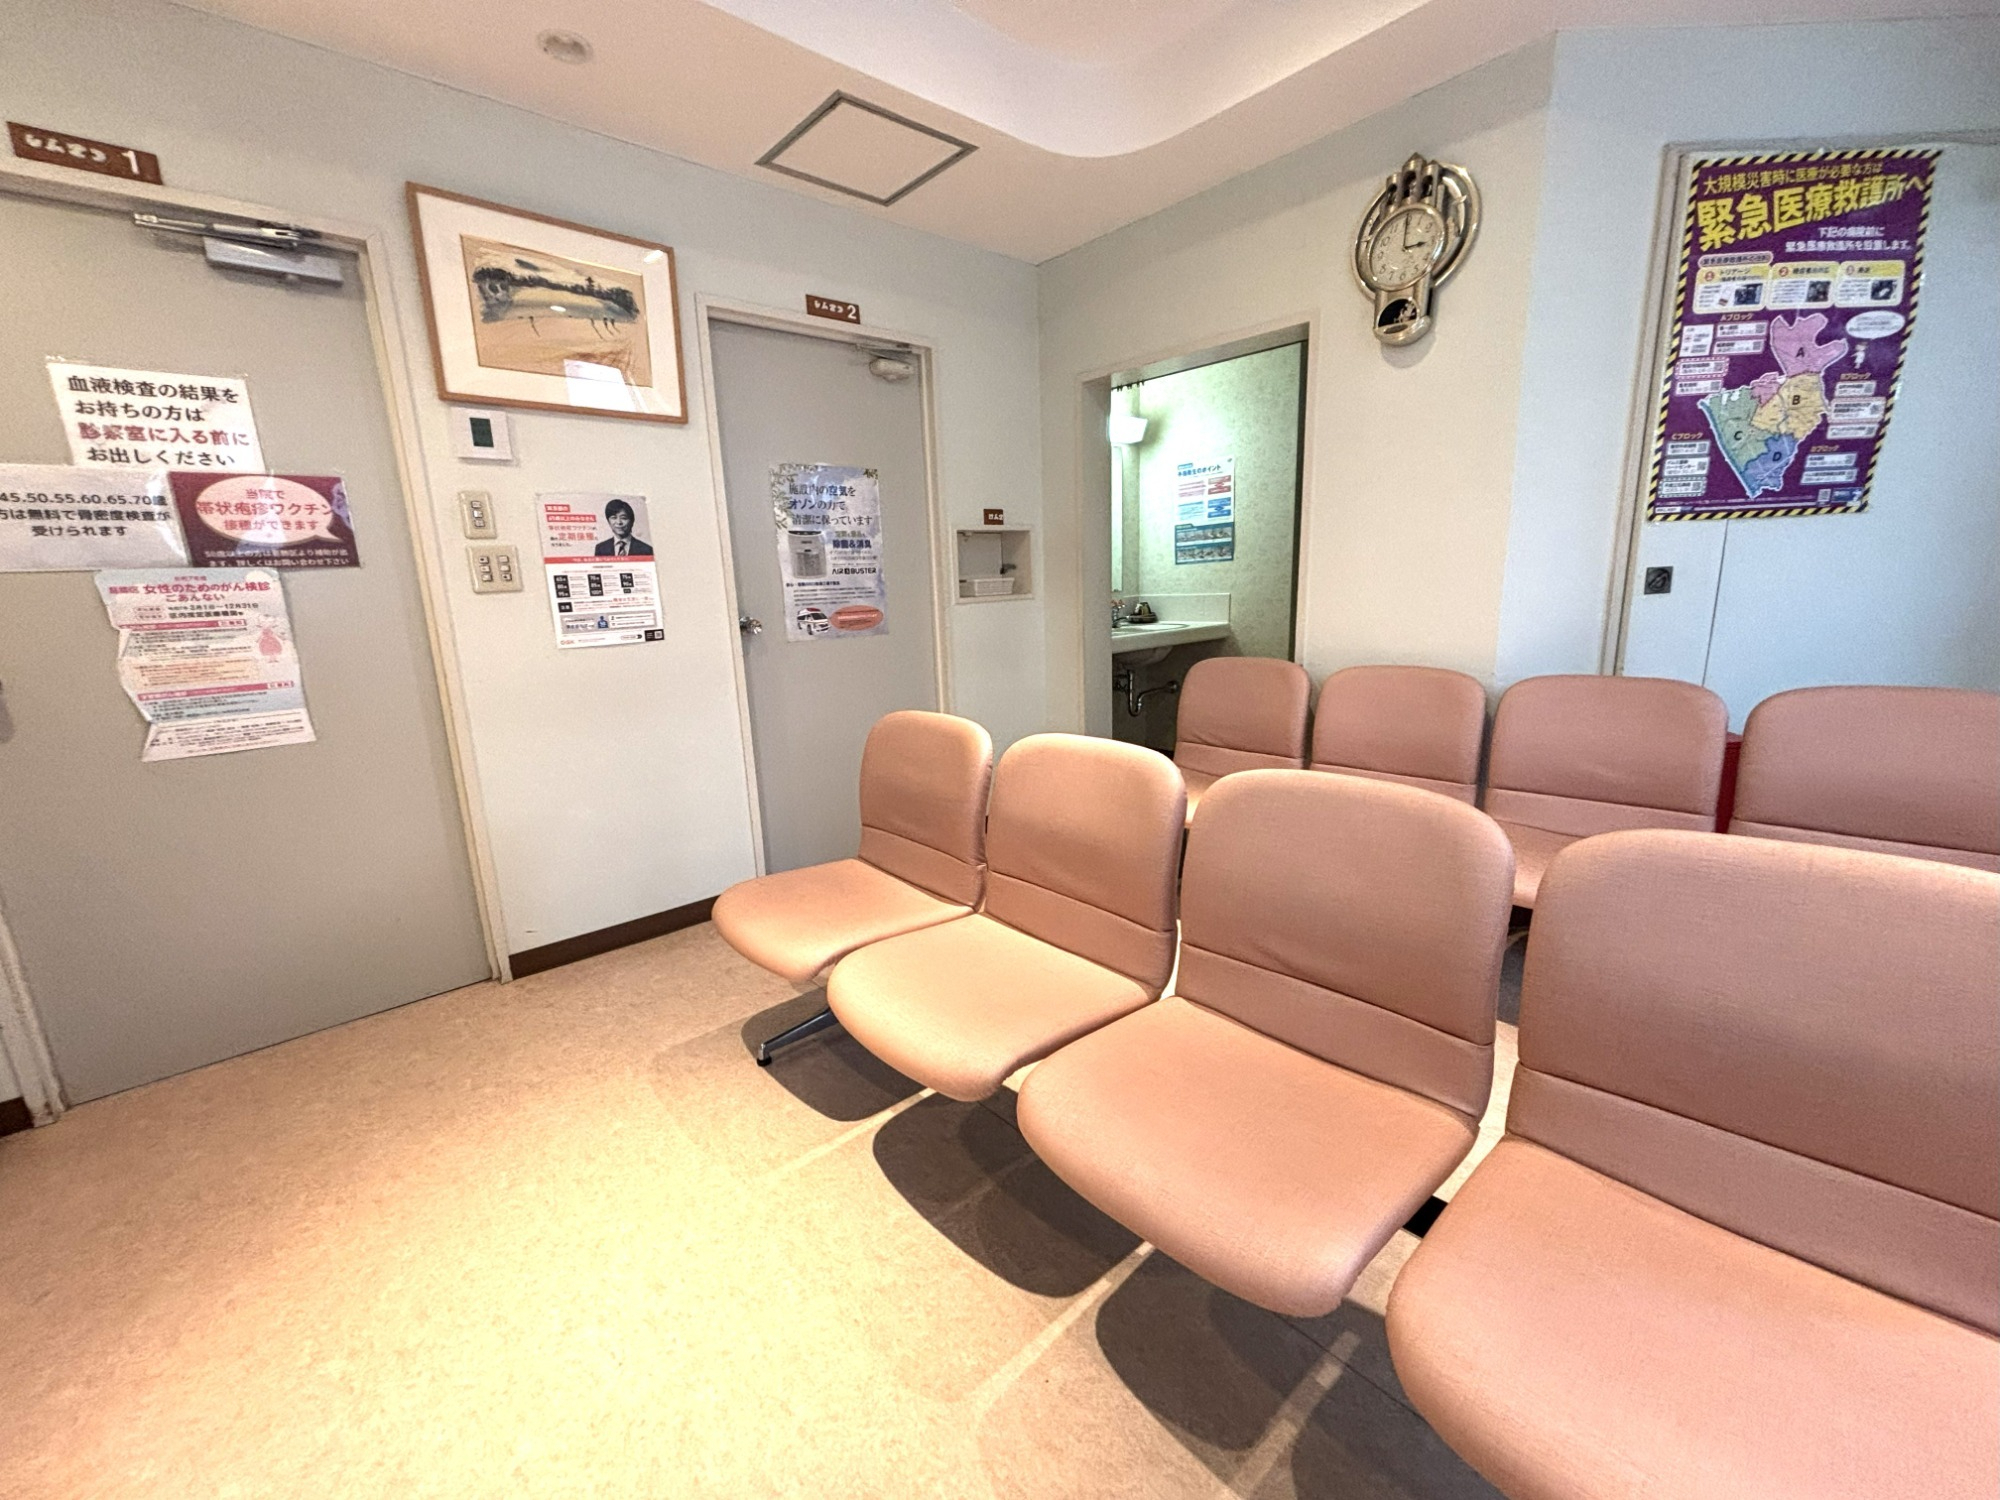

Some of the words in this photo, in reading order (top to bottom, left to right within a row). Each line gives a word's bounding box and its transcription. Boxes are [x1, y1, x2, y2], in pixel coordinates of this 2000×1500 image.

[121, 150, 140, 175] 1
[1703, 162, 1883, 194] 大規模災害時に医療が必要な方は
[1697, 174, 1925, 251] 緊急医療救護所へ
[1380, 236, 1390, 247] 10
[847, 304, 857, 319] 2
[1796, 348, 1805, 358] A
[68, 376, 239, 403] 血液検査の結果を
[1792, 395, 1801, 406] B
[75, 400, 205, 422] お持ちの方は
[78, 422, 250, 446] 診察室に入る前に
[1734, 431, 1742, 441] C
[87, 447, 235, 466] お出しください
[1772, 451, 1782, 462] D
[245, 489, 286, 500] 当院で
[789, 483, 857, 497] 施設内の空気を
[196, 502, 333, 516] 帯状疱疹ワクチン
[789, 499, 846, 511] オゾンの力で
[224, 520, 319, 531] 接種ができます
[792, 514, 873, 526] 清潔に保っています
[32, 526, 128, 537] 受けられます
[850, 567, 877, 575] BUSTER
